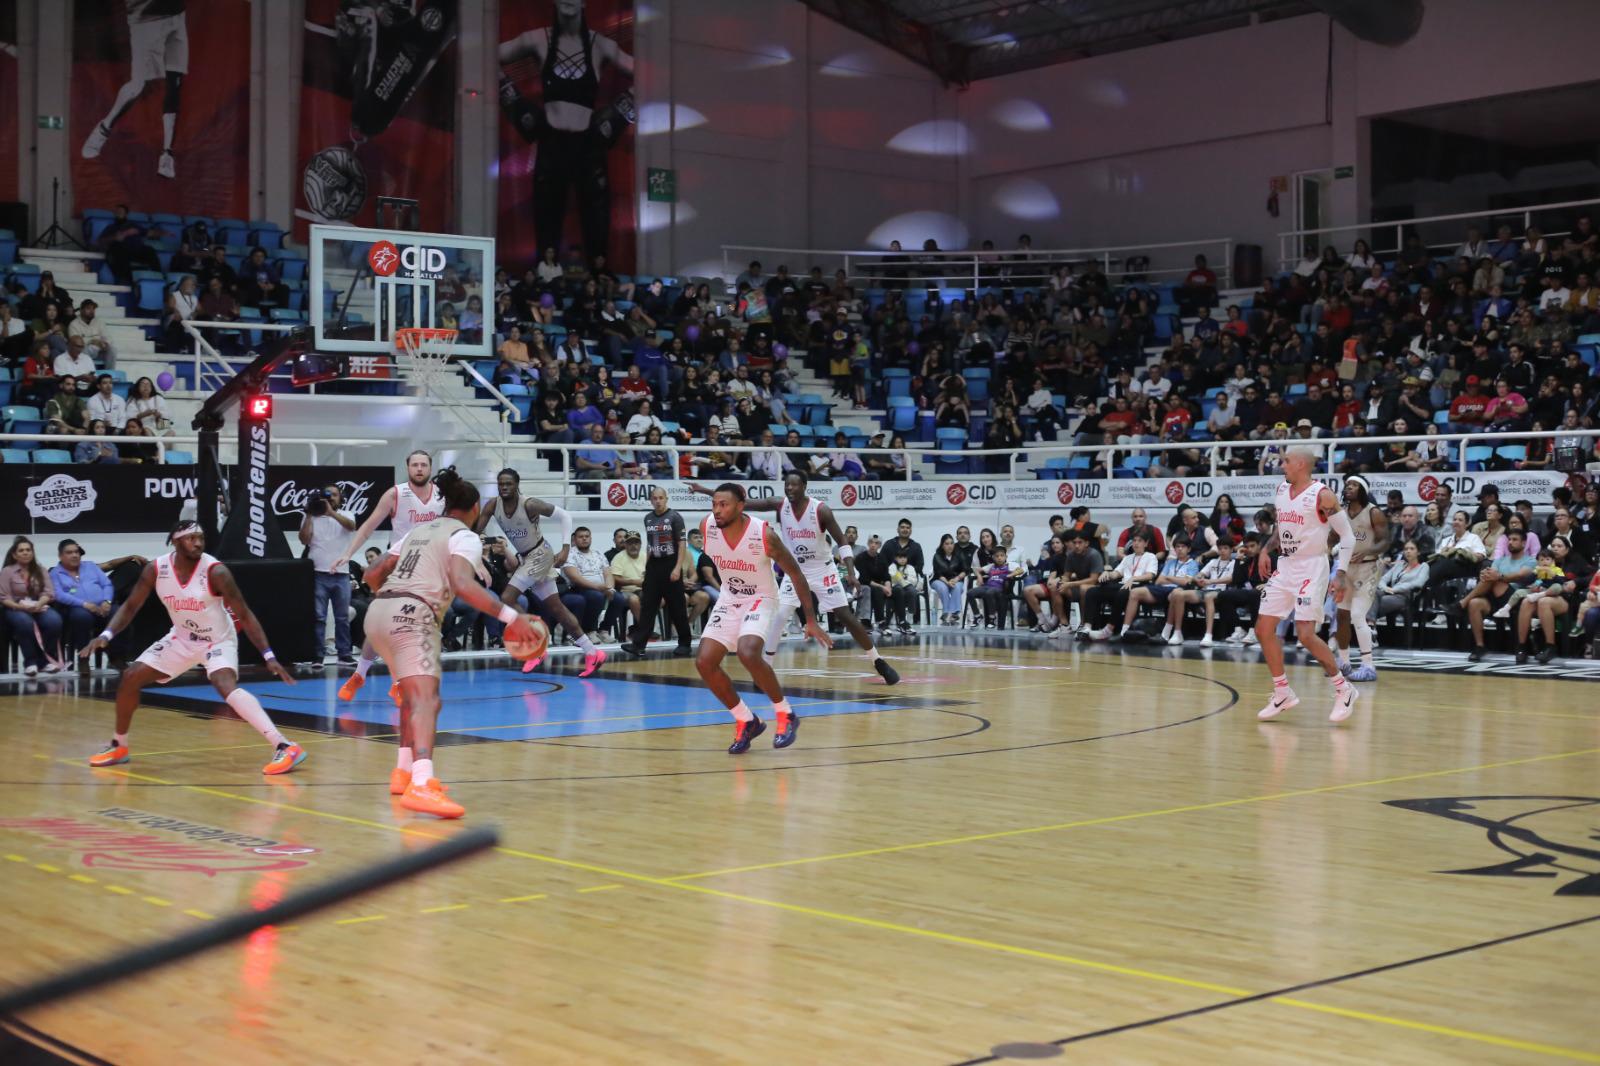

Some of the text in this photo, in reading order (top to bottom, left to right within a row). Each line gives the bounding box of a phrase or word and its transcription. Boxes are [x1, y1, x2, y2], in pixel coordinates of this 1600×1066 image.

[401, 246, 447, 273] CID
[34, 486, 86, 499] CARNES
[145, 477, 198, 498] POW
[246, 425, 267, 557] dportenis
[747, 485, 774, 499] CID
[858, 485, 883, 500] UAD
[968, 485, 997, 500] CID
[1075, 483, 1101, 499] UAD
[1185, 481, 1213, 498] CID
[34, 493, 88, 506] SELECTAS
[42, 502, 81, 511] NAYARIT
[398, 548, 421, 579] 44
[823, 574, 838, 588] 42
[1299, 578, 1311, 595] 2
